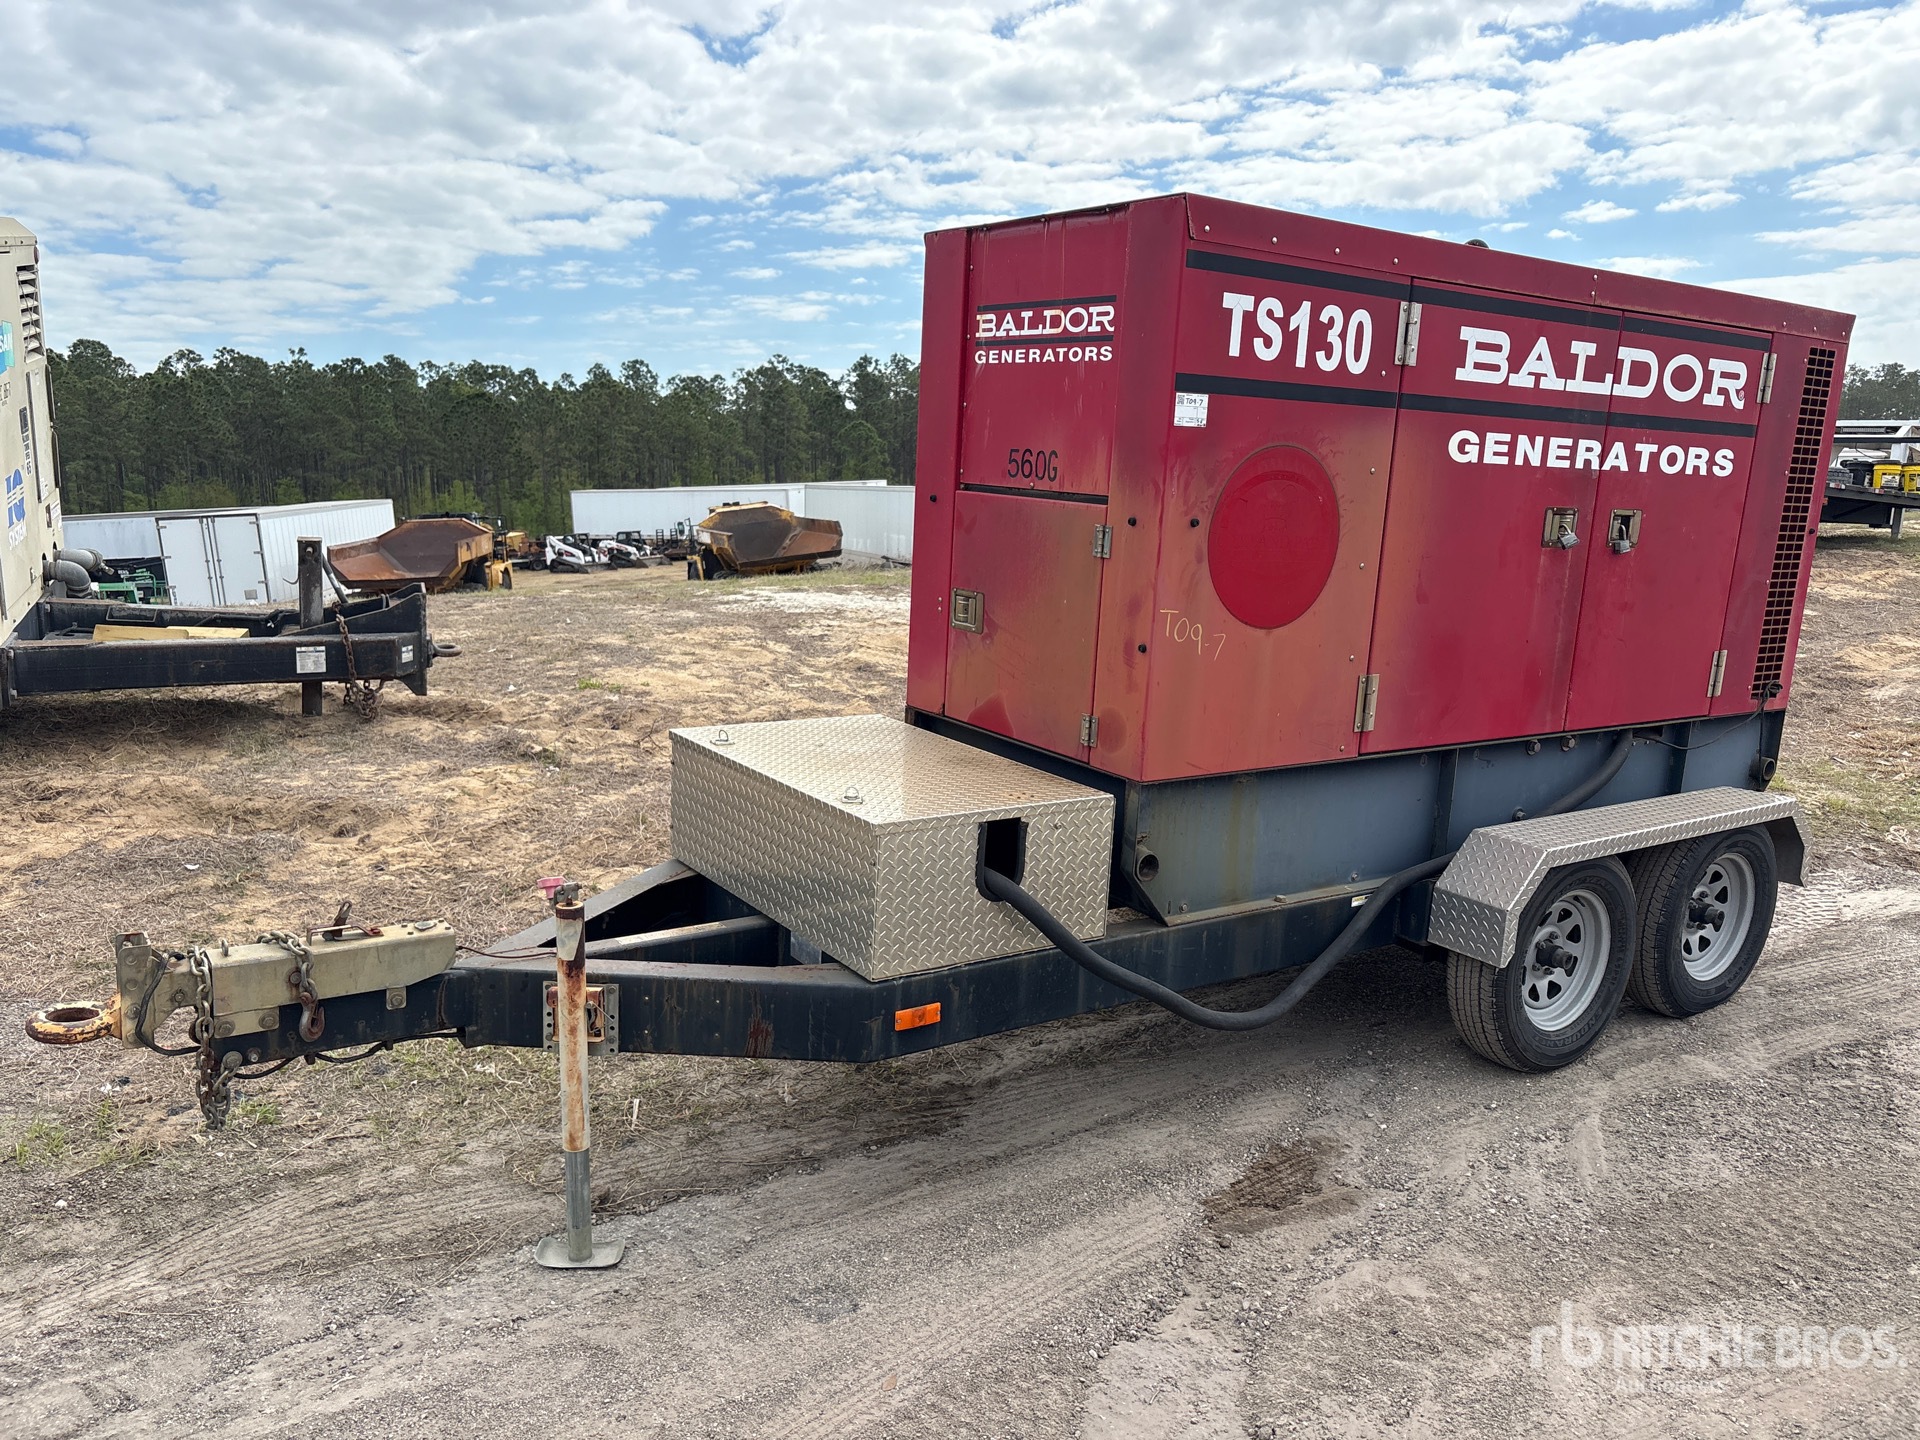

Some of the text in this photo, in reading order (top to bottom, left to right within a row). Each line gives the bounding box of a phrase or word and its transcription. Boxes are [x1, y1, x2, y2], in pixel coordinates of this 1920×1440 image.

[975, 304, 1115, 338] BALDOR
[1222, 290, 1373, 375] TS130
[974, 345, 1113, 365] GENERATORS
[1007, 448, 1059, 482] 560G
[1447, 429, 1735, 476] GENERATORS
[5, 468, 27, 530] IQ
[8, 522, 28, 551] SYSTEM
[1159, 608, 1226, 661] T09-7
